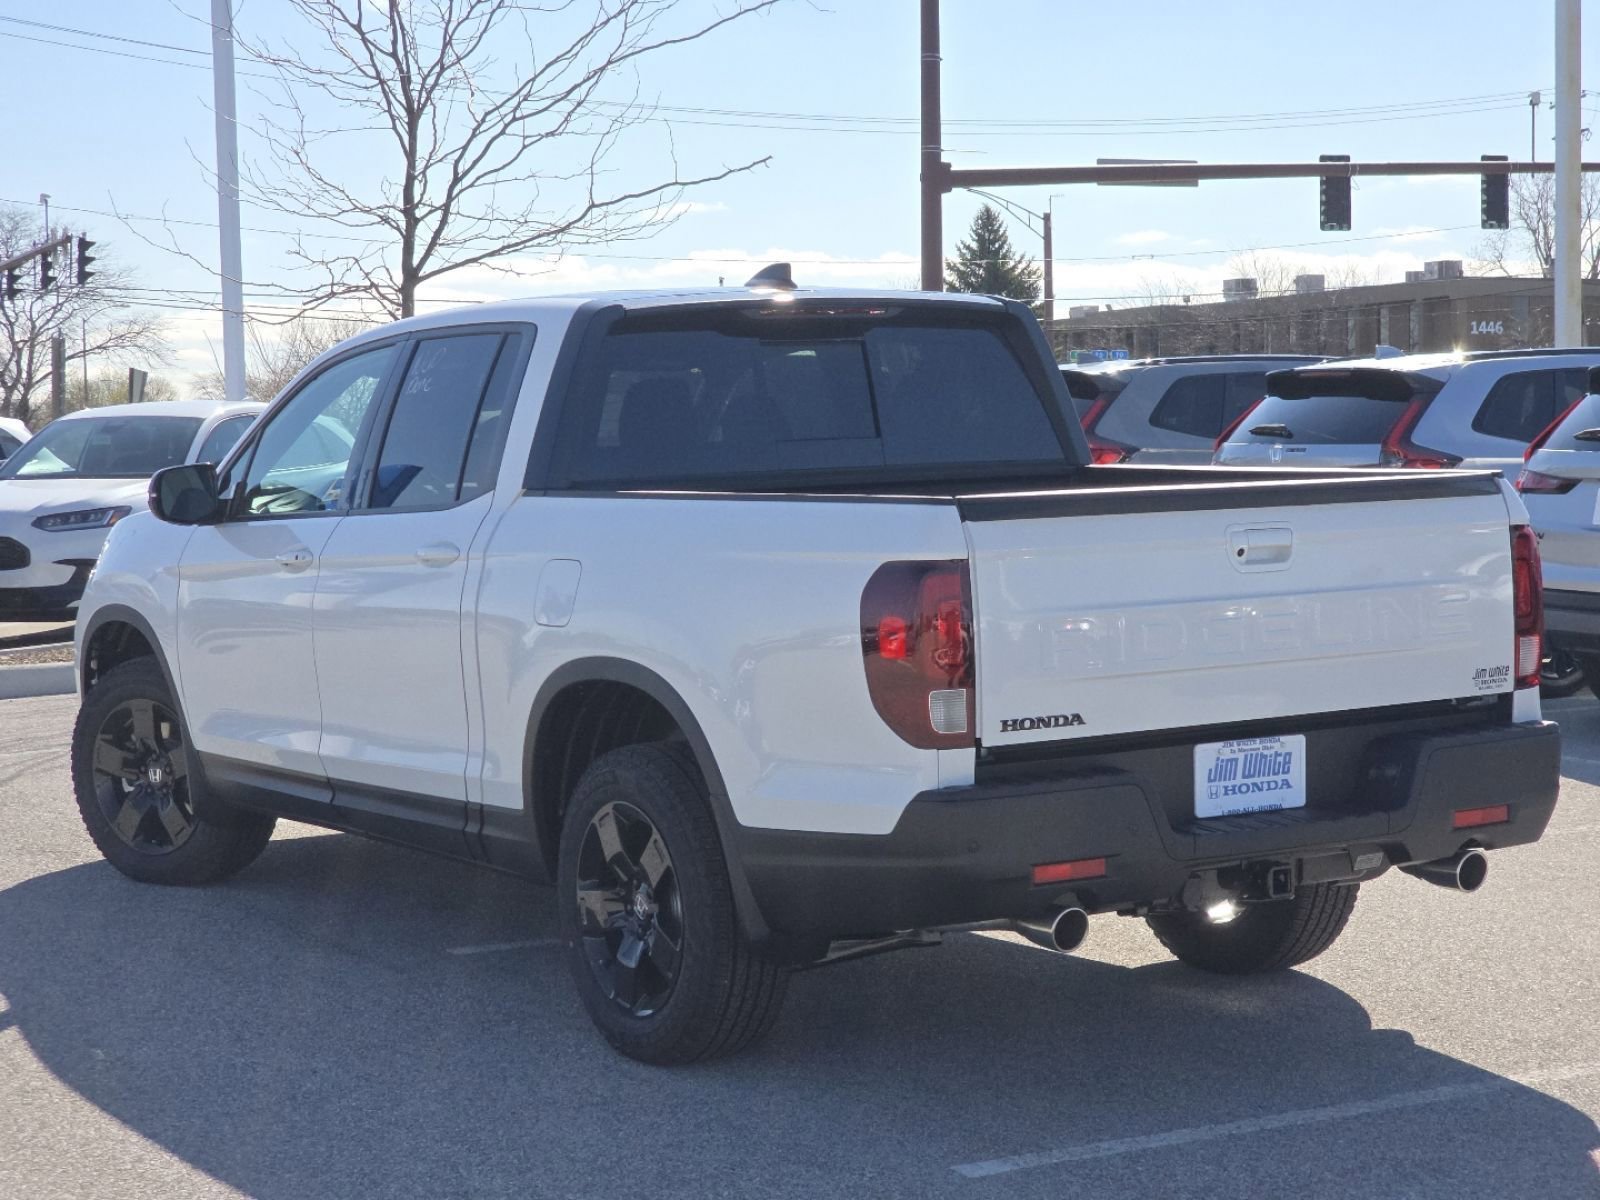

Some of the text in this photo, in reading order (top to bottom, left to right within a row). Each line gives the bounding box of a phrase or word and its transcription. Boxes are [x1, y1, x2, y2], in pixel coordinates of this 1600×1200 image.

[1471, 320, 1504, 335] 1446
[1000, 713, 1086, 732] HONDA
[1236, 739, 1257, 747] WHITE
[1241, 751, 1292, 780] White
[1223, 779, 1292, 796] HONDA
